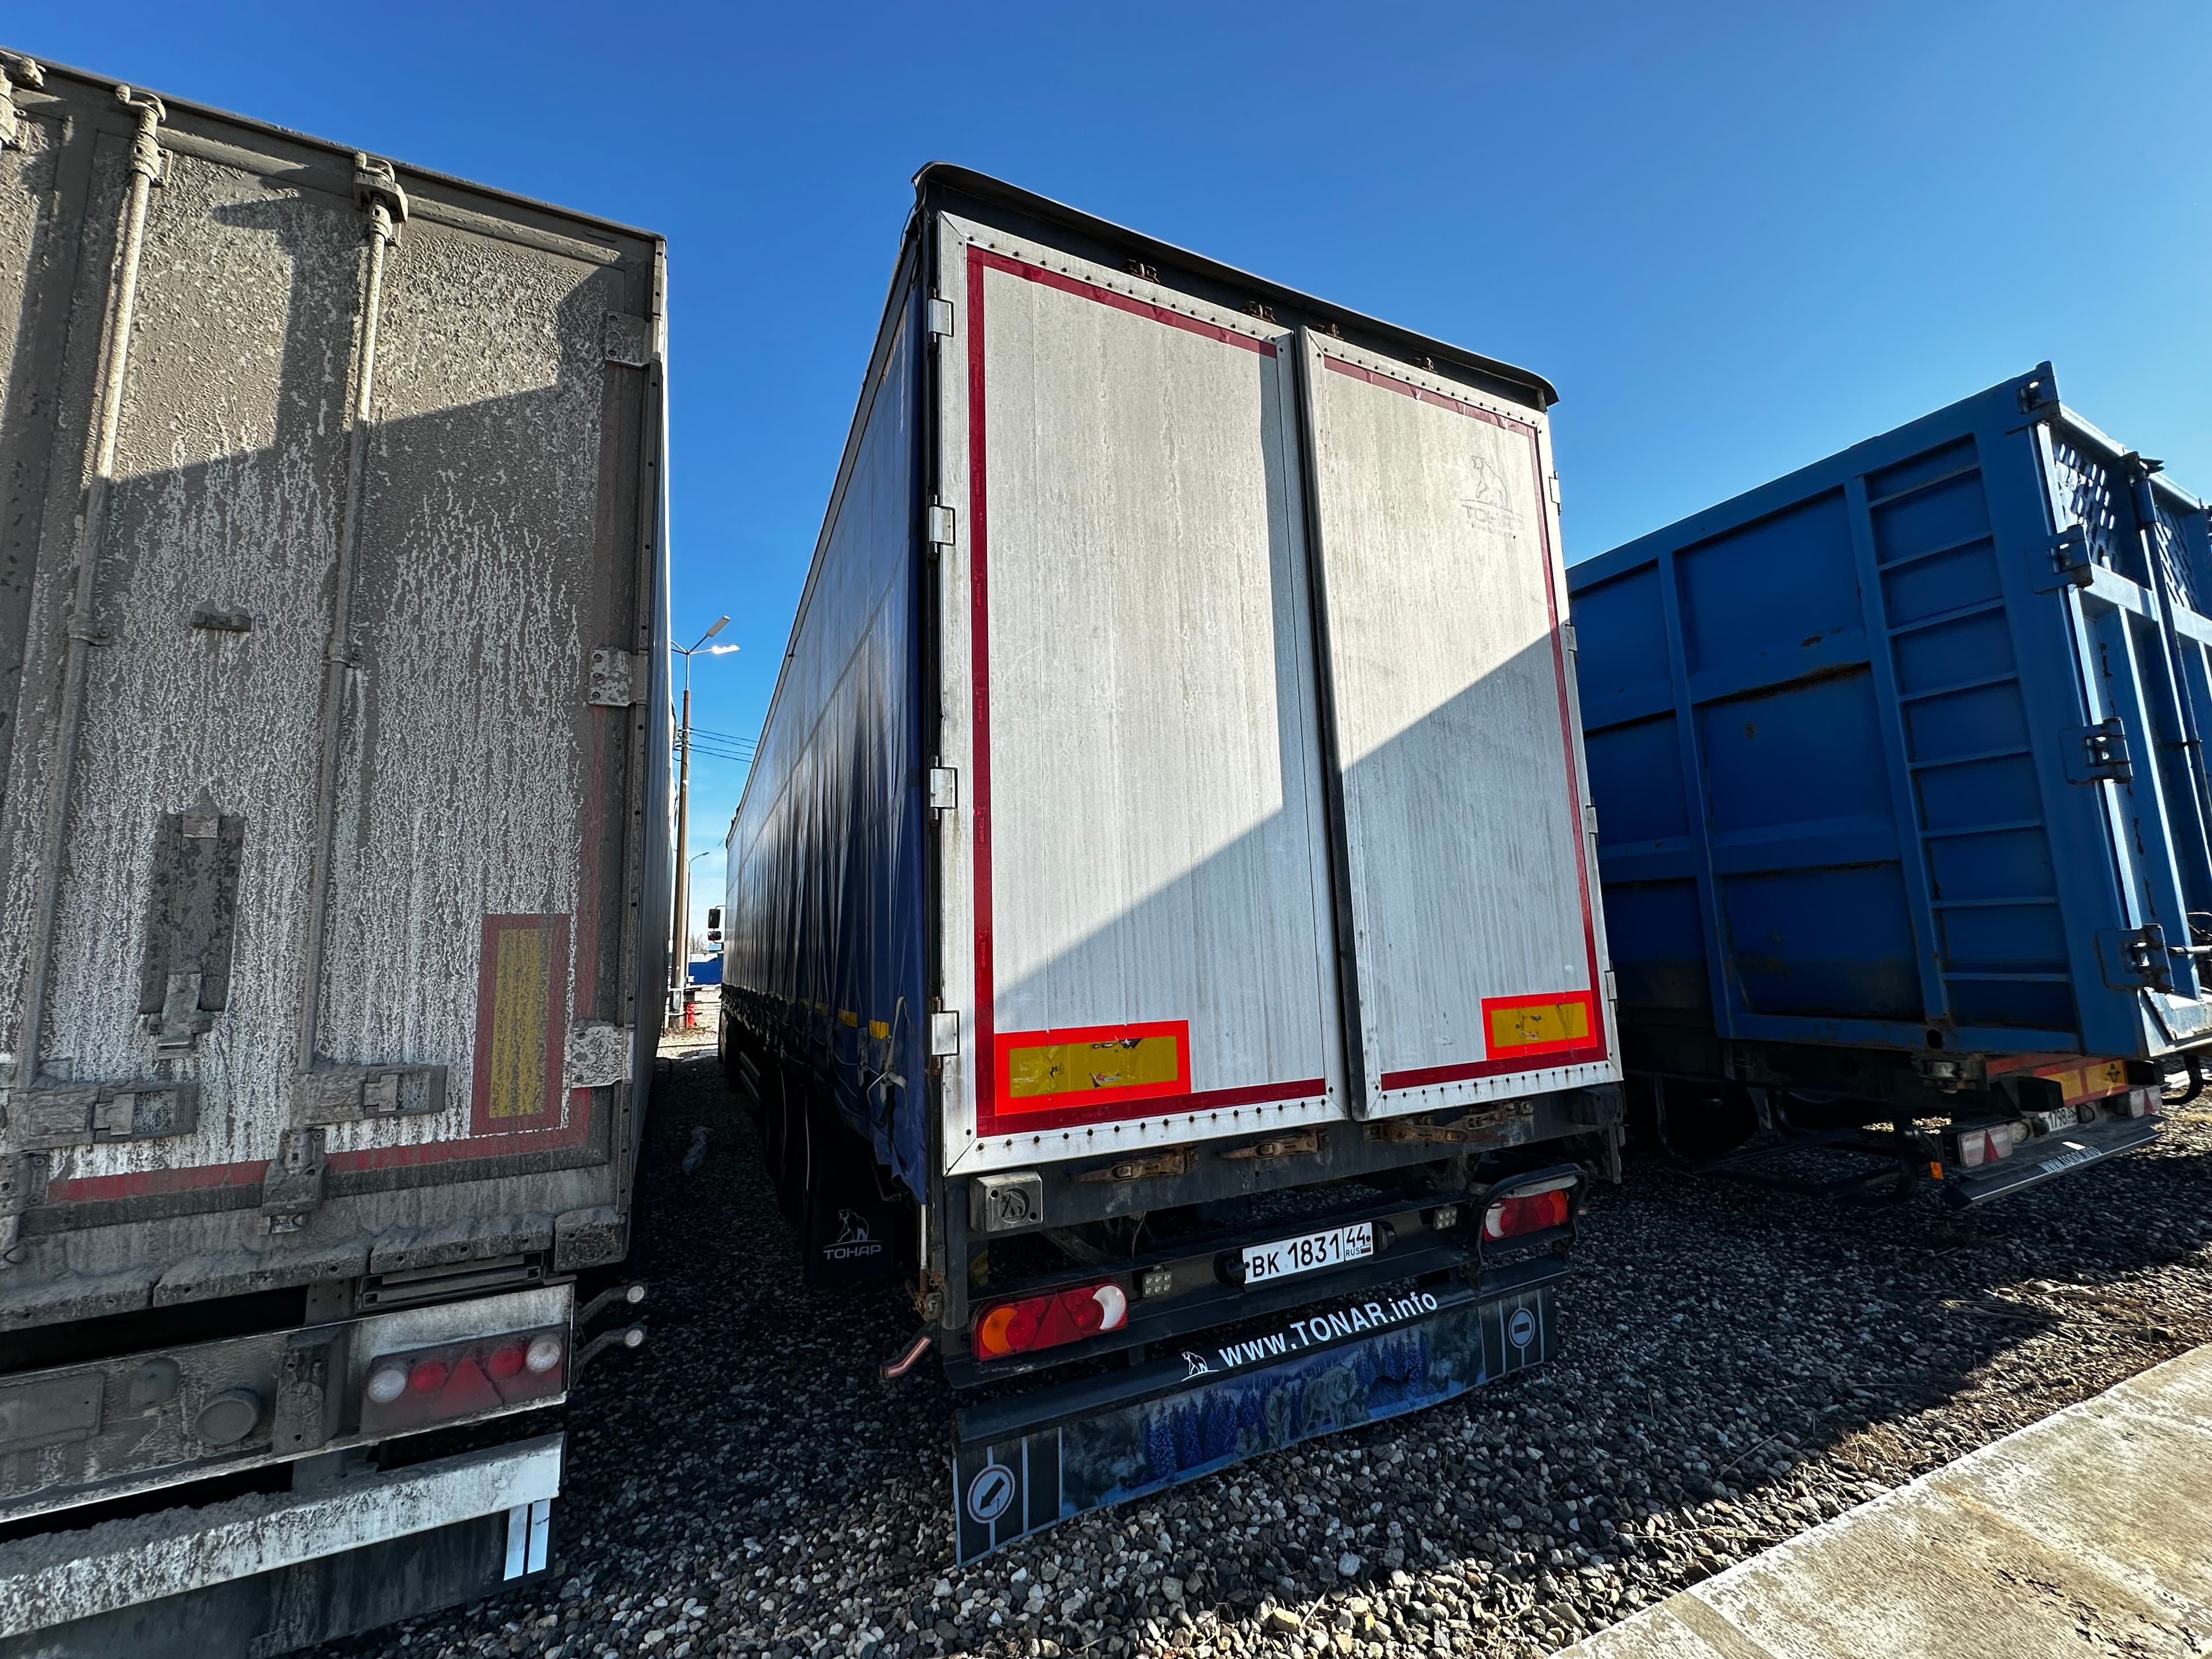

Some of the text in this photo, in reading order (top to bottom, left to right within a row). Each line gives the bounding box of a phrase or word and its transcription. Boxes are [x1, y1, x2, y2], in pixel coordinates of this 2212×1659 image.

[823, 1244, 881, 1260] ТОНАР
[1287, 1233, 1340, 1269] 1831
[1346, 1226, 1366, 1248] 44
[1346, 1247, 1360, 1257] RUS
[1218, 1291, 1438, 1368] www.TONAR.info
